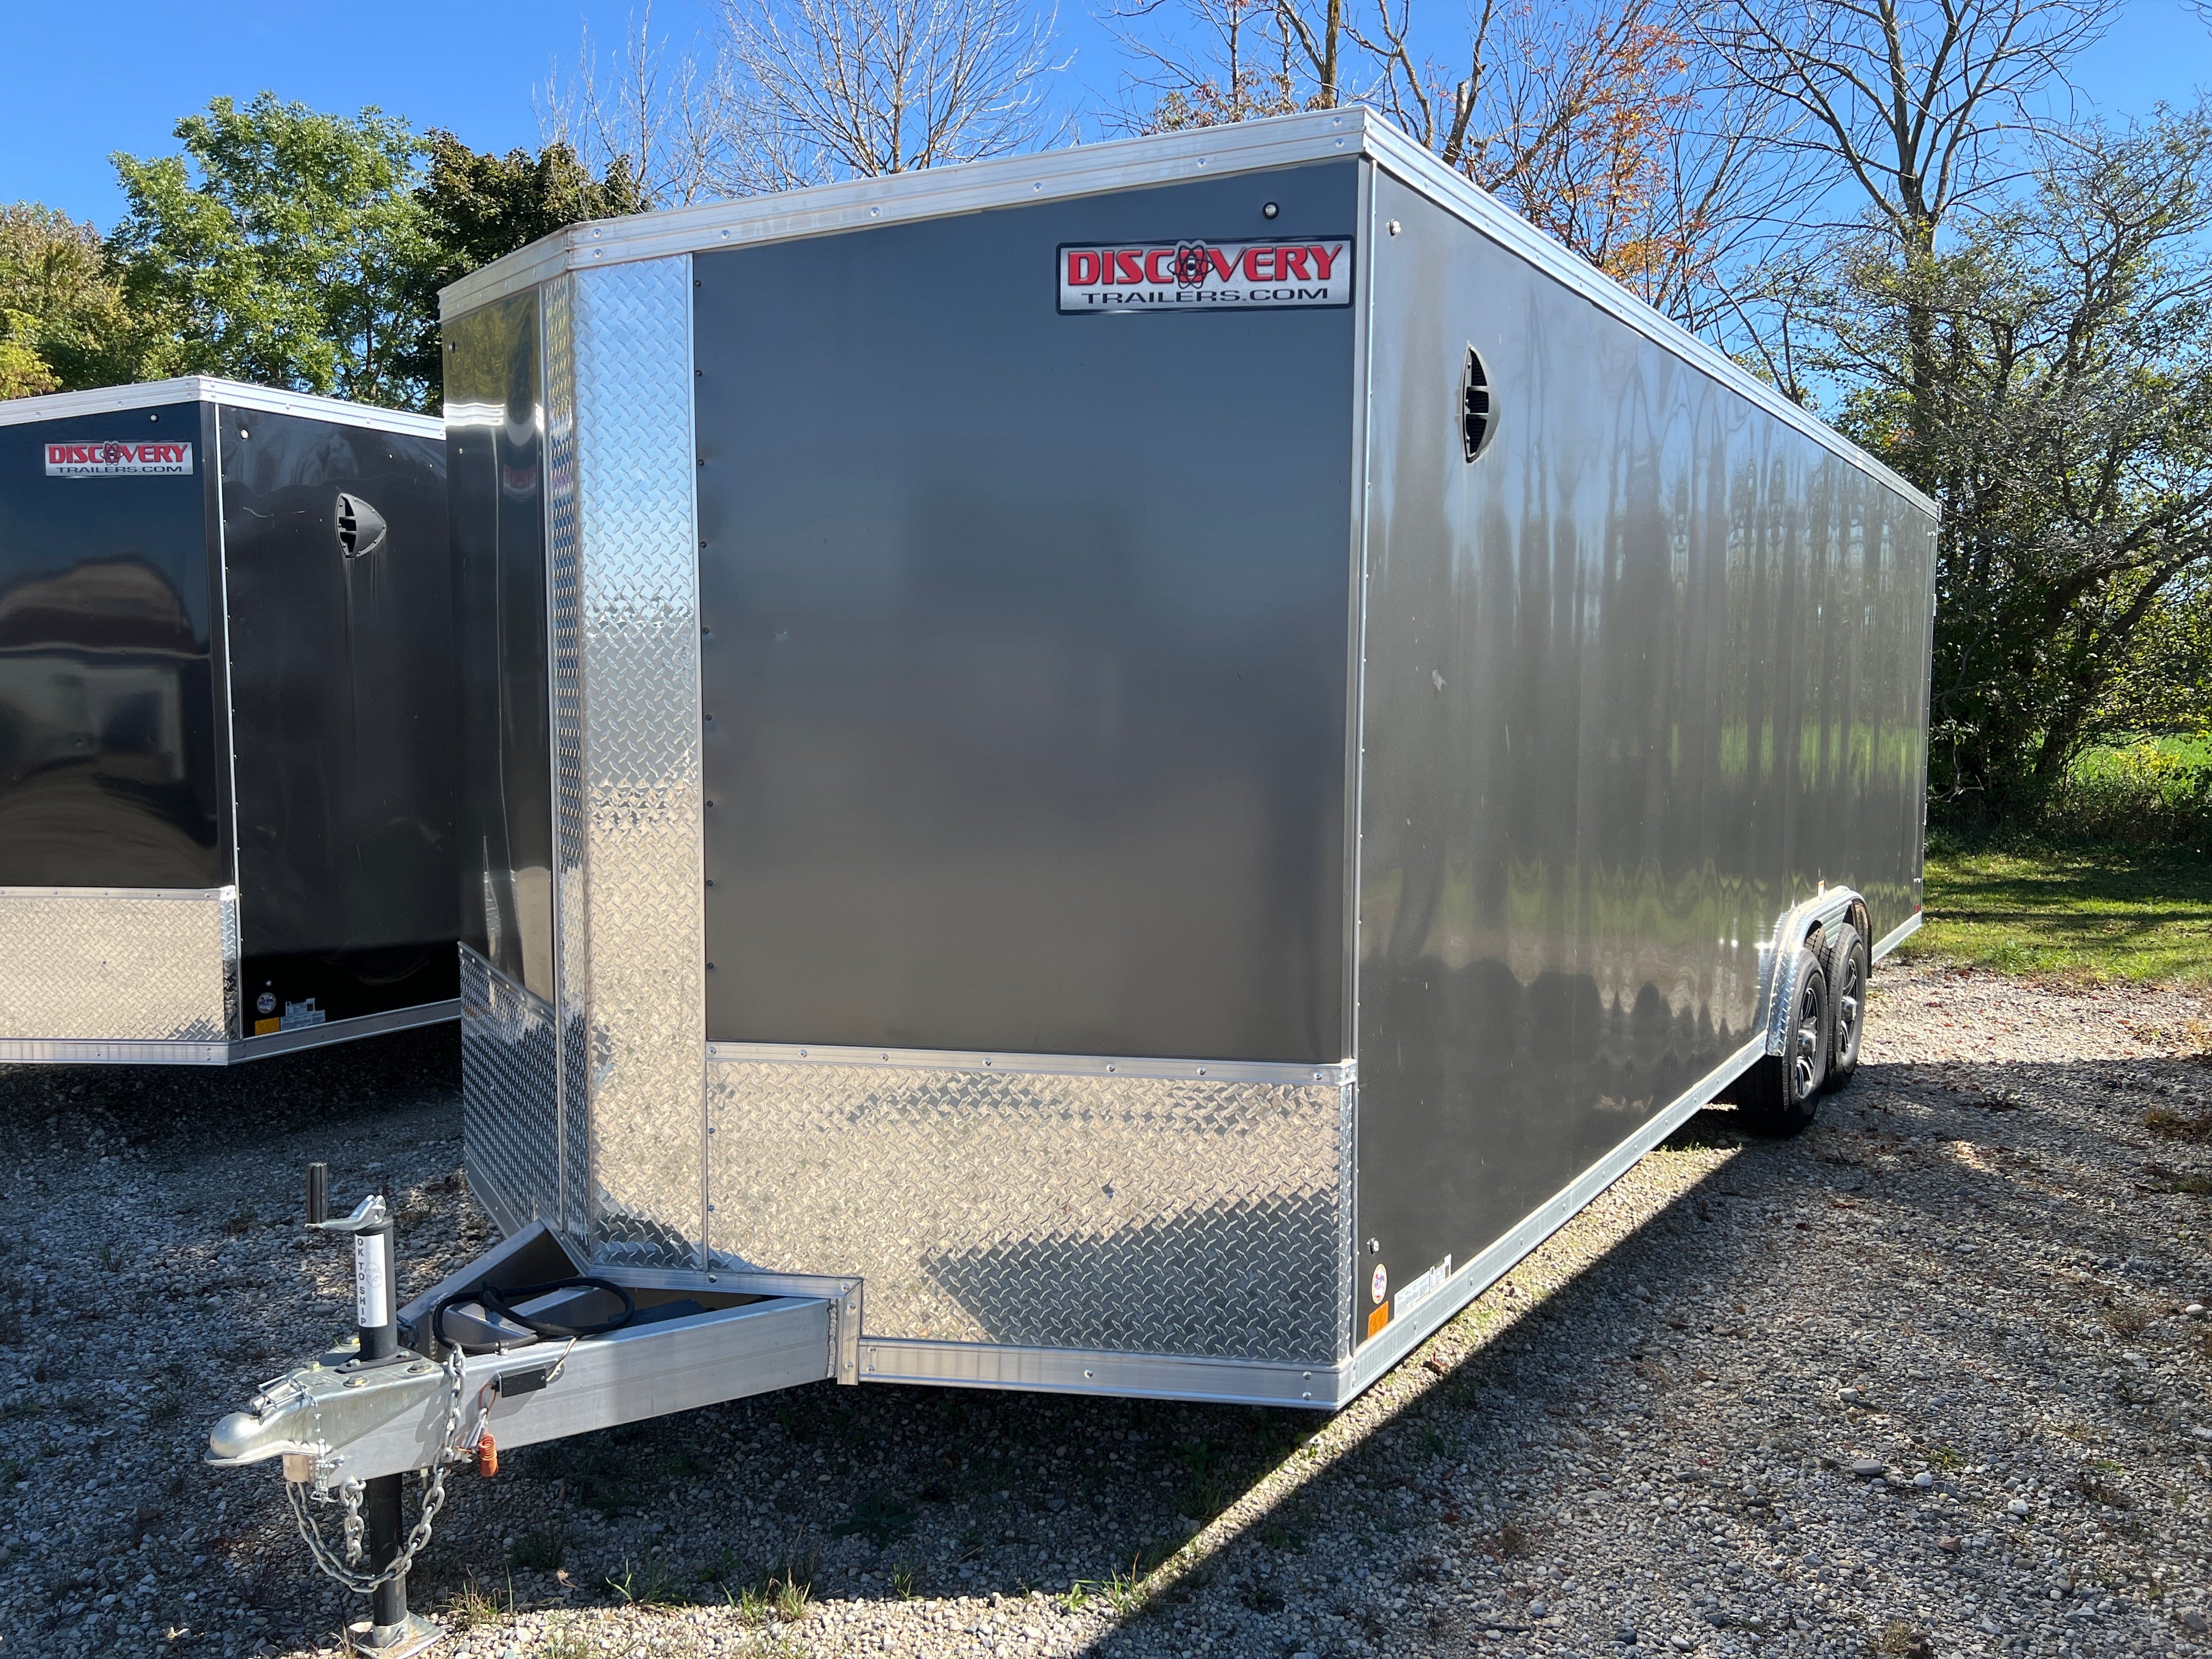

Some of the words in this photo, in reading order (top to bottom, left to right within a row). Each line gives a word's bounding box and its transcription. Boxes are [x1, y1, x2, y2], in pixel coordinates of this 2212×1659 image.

[1068, 244, 1343, 286] DISCOVERY
[1081, 288, 1328, 304] TRAILERS.COM
[48, 444, 188, 464] DISCOVERY
[56, 465, 183, 474] TRAILERS.COM
[357, 1238, 364, 1257] OK
[358, 1262, 365, 1281] TO
